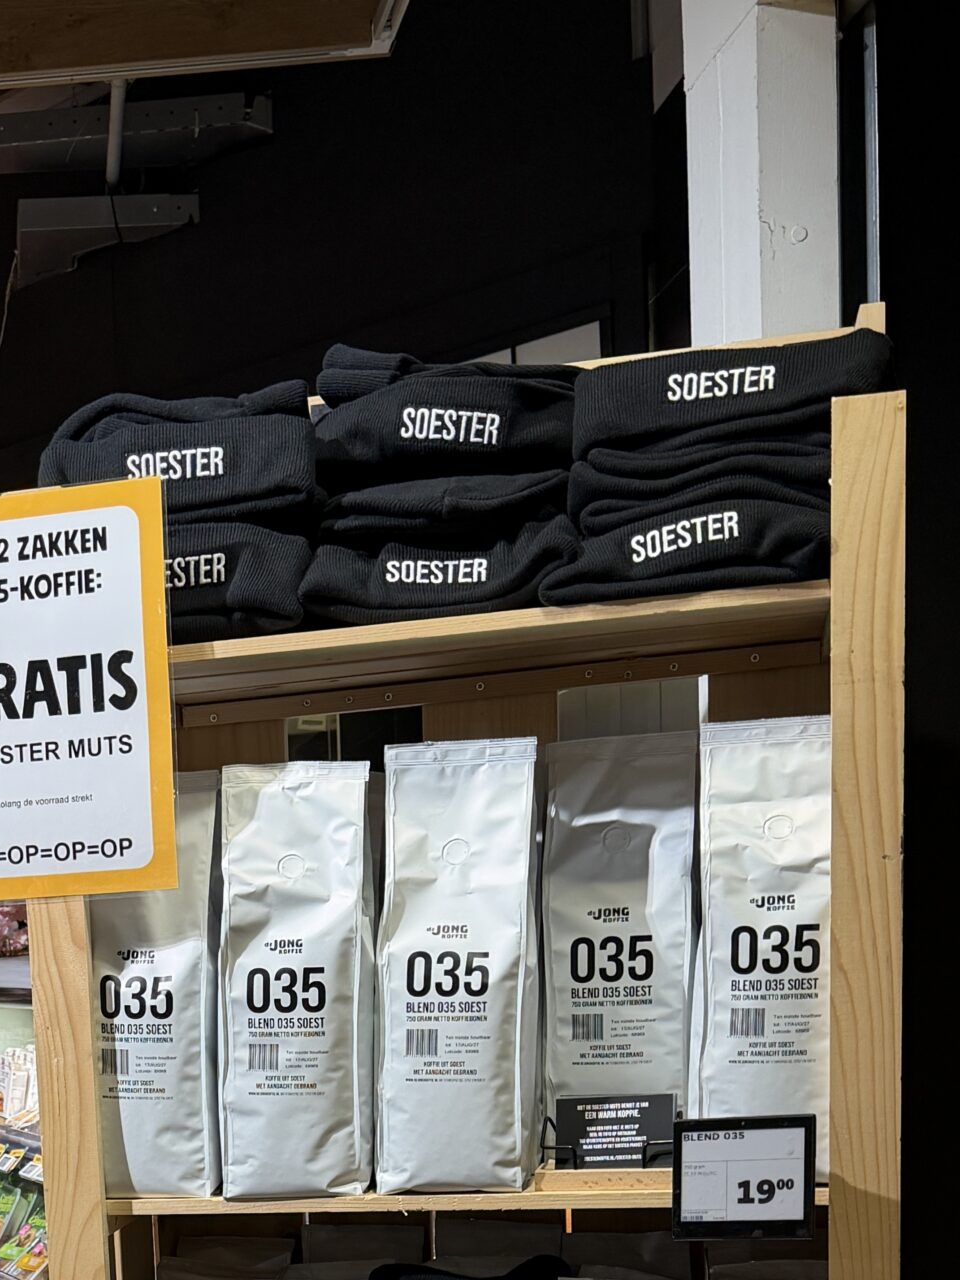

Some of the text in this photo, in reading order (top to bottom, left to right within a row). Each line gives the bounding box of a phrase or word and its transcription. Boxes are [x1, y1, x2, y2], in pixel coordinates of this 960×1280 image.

[666, 363, 777, 403] SOESTER
[399, 405, 502, 447] SOESTER
[126, 446, 224, 480] SOESTER
[17, 526, 108, 561] ZAKKEN
[628, 509, 741, 565] SOESTER
[164, 552, 226, 588] ESTER
[384, 556, 489, 586] SOESTER
[67, 734, 133, 760] MUTS
[23, 797, 34, 808] de
[34, 794, 70, 806] voorraad
[70, 793, 93, 804] strekt
[570, 934, 654, 984] 035
[730, 923, 821, 975] 035
[246, 966, 326, 1013] 035
[406, 950, 490, 998] 035
[731, 978, 819, 992] BLEND 035 SOEST
[99, 974, 174, 1020] 035
[406, 1001, 487, 1013] BLEND 035 SOEST
[571, 985, 653, 999] BLEND 035 SOEST
[101, 1023, 173, 1035] BLEND 035 SOEST
[248, 1017, 325, 1029] BLEND 035 SOEST
[585, 1111, 597, 1120] EEN
[597, 1110, 617, 1119] WARM
[683, 1131, 745, 1142] BLEND 035
